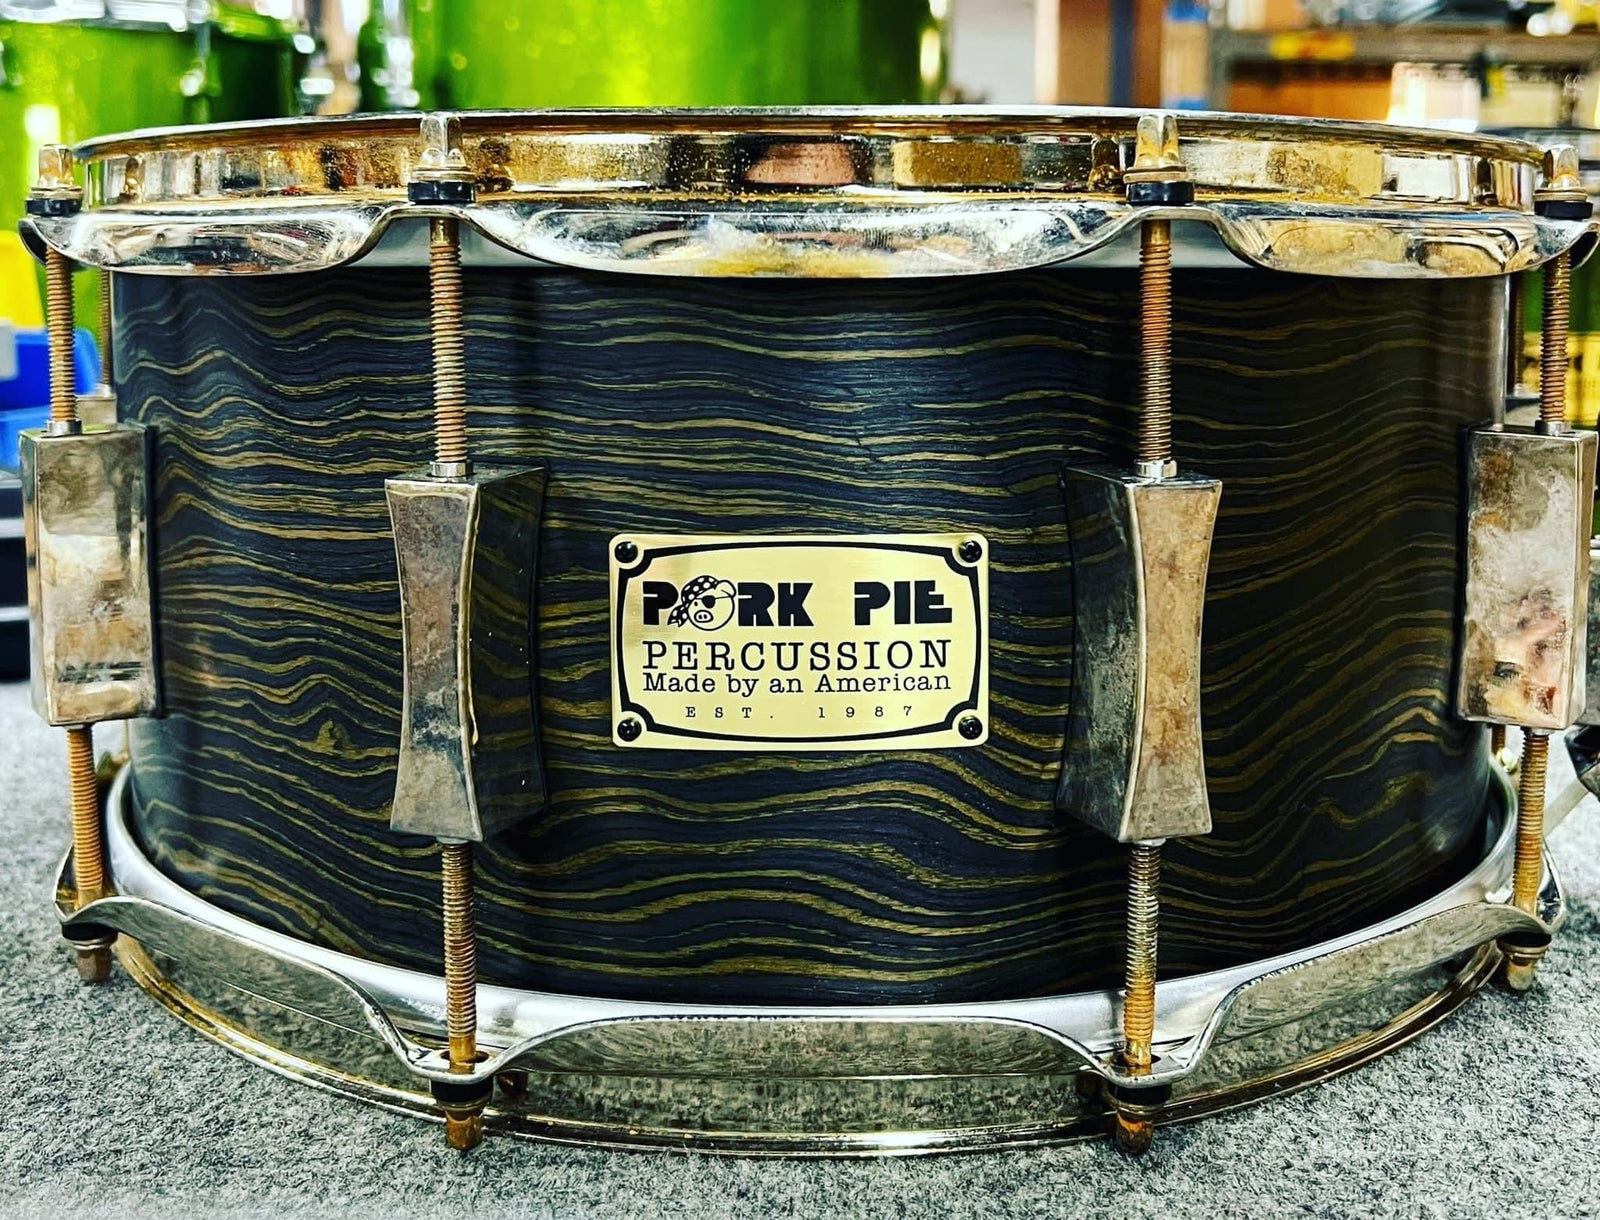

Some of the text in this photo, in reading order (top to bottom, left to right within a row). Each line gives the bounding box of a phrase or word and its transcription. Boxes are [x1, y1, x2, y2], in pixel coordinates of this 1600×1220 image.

[854, 579, 953, 627] PIE
[642, 639, 952, 672] PERCUSSION
[642, 672, 951, 698] Made by an American
[817, 705, 913, 719] 1987
